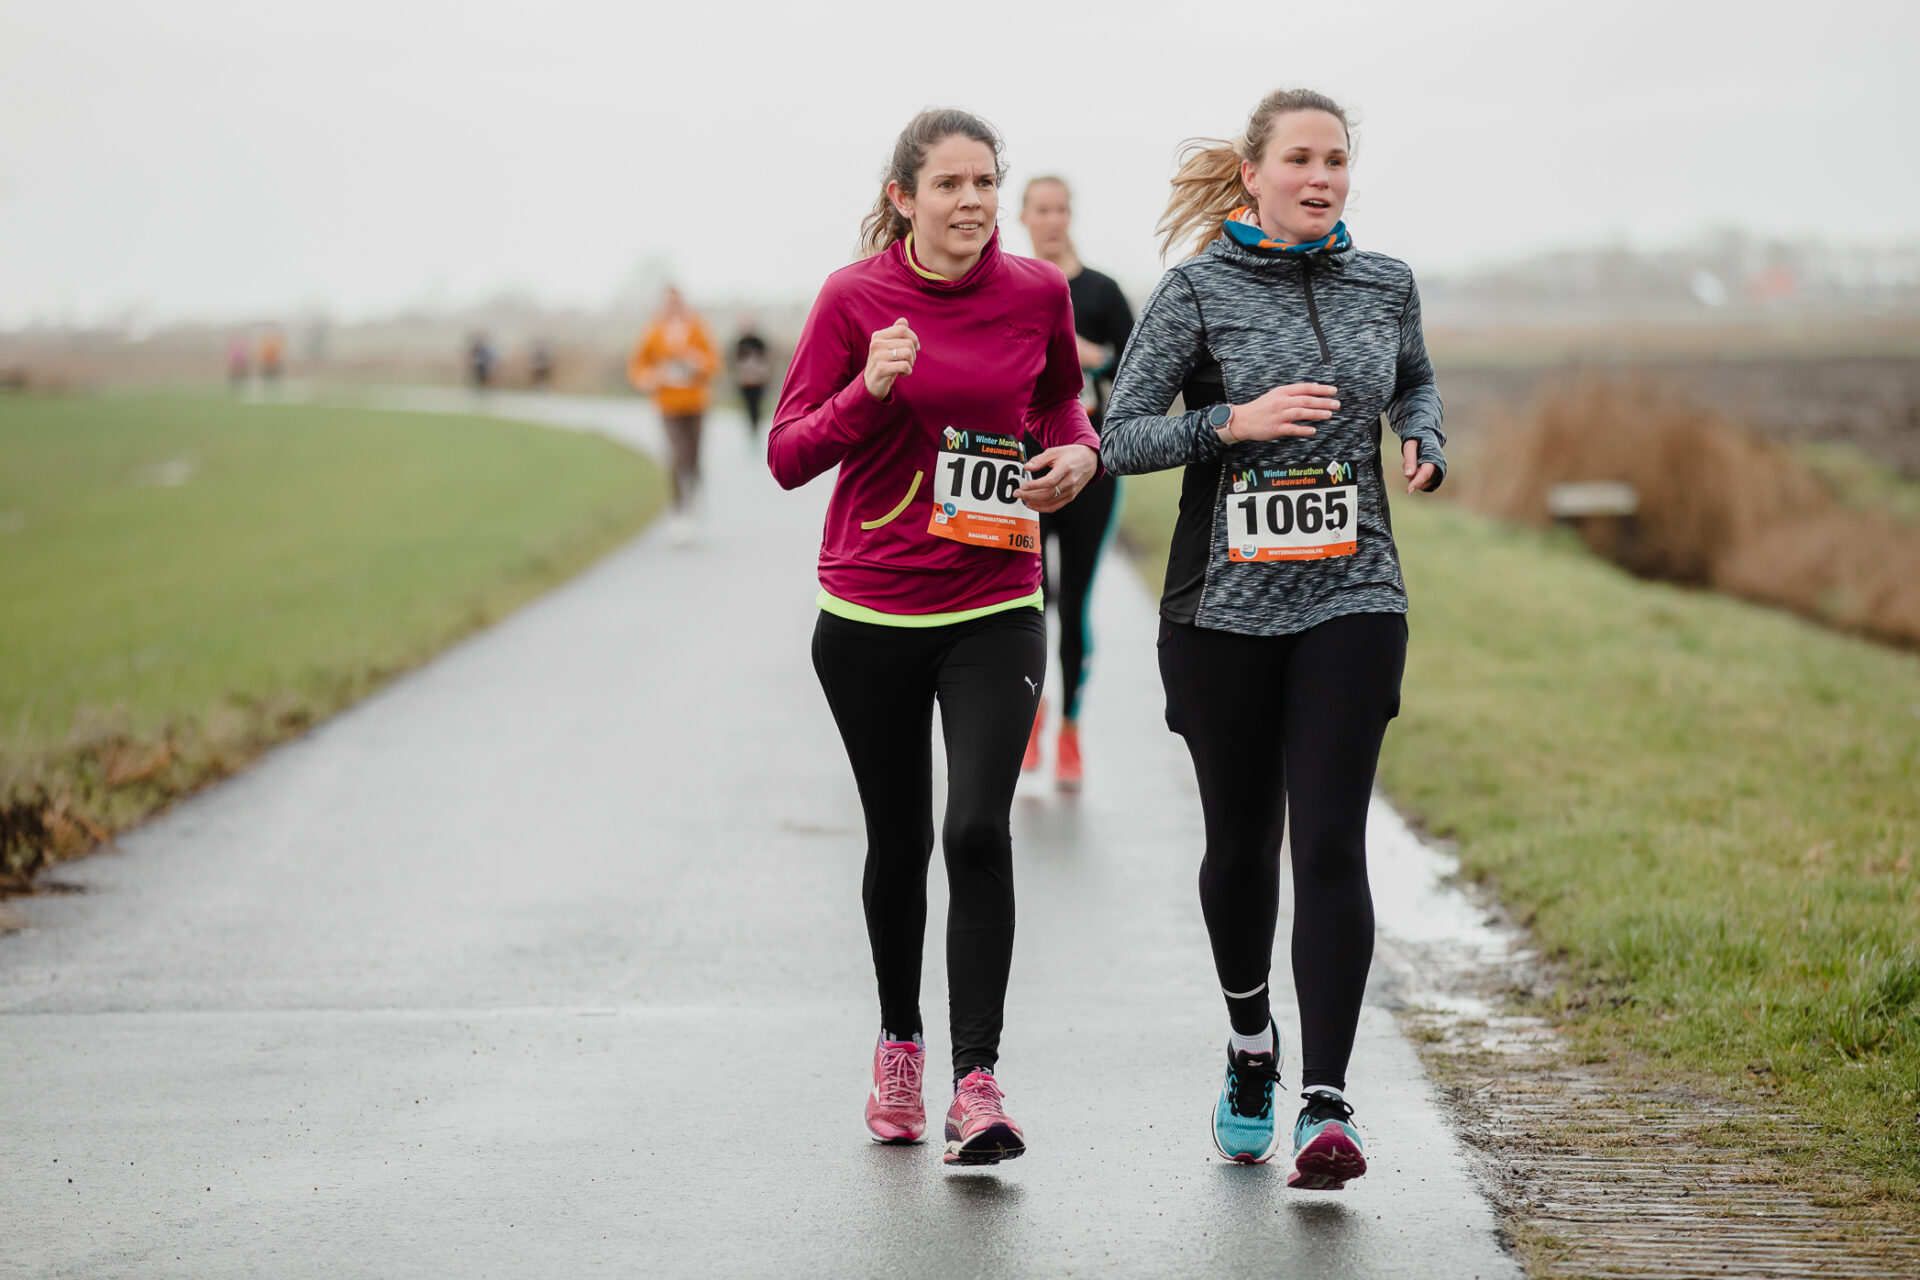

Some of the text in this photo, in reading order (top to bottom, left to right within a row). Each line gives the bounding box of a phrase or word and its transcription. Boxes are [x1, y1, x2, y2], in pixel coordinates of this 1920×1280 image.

[976, 435, 998, 445] Winter
[981, 445, 1018, 457] Leeuwarden
[1263, 469, 1288, 478] Winter
[1288, 467, 1324, 477] Marathon
[946, 457, 1029, 507] 106
[1271, 477, 1317, 487] Leeuwarden
[1237, 490, 1348, 536] 1065
[1008, 533, 1035, 549] 1063
